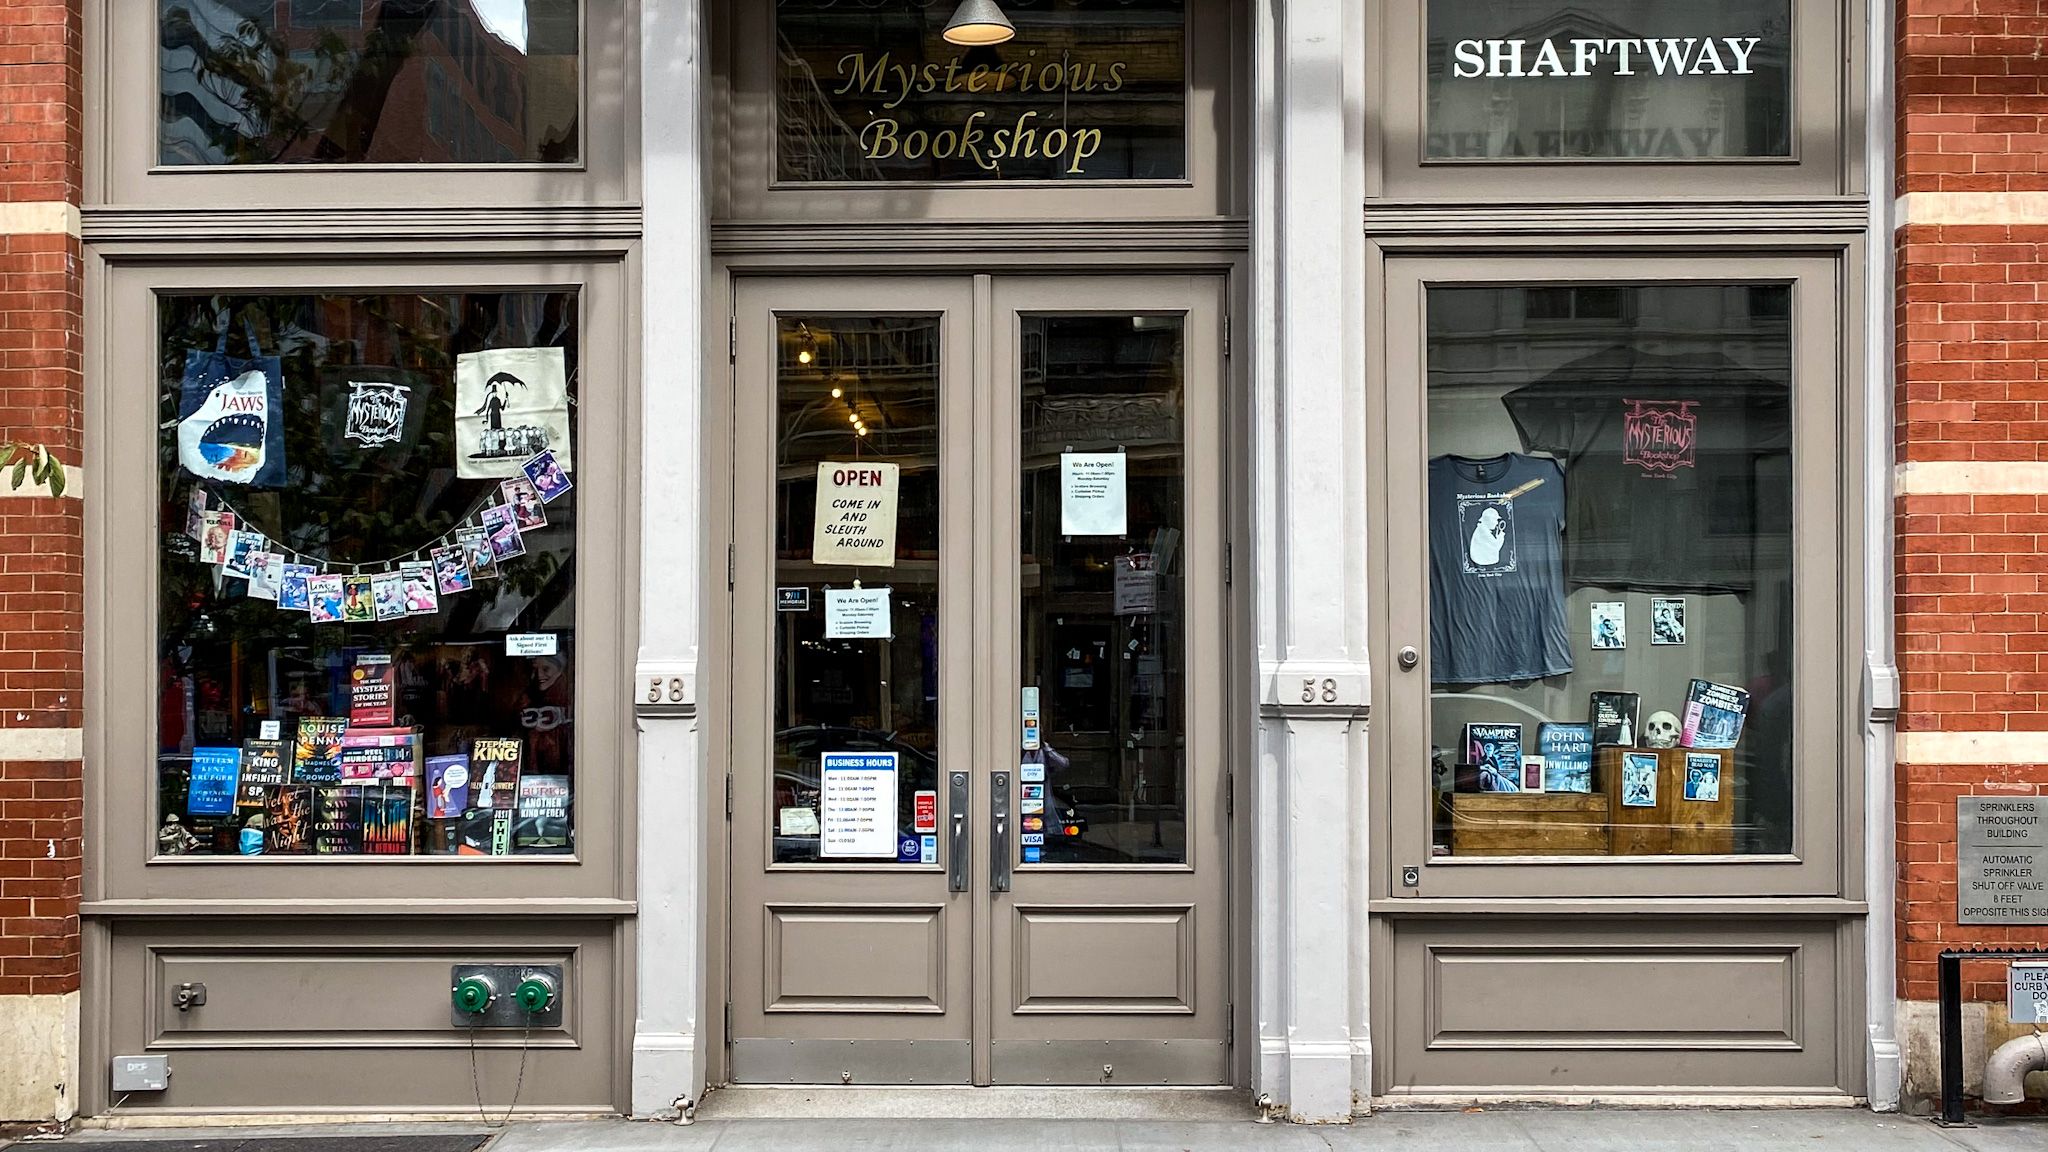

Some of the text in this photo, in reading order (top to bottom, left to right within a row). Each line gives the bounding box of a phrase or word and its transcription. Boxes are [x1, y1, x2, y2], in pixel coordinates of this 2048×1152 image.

[1453, 37, 1761, 78] SHAFTWAY
[834, 50, 1128, 109] Mysterious
[860, 111, 1102, 174] Bookshop
[221, 394, 264, 412] JAWS
[1628, 420, 1692, 454] MYSTERIOUS
[833, 470, 882, 487] OPEN
[832, 499, 881, 509] COME IN
[840, 513, 867, 522] AND
[825, 525, 867, 535] SLEUTH
[836, 538, 884, 548] AROUND
[785, 591, 800, 600] 9/11
[352, 685, 391, 693] MYSTERY
[648, 677, 684, 702] 58
[1302, 678, 1337, 703] 58
[1710, 684, 1738, 697] ZOMBIES!
[353, 693, 389, 701] STORIES
[1705, 688, 1740, 704] ZOMBIES!
[1699, 694, 1744, 713] ZOMBIES!
[301, 724, 345, 733] LOUISE
[1475, 727, 1517, 740] VAMPIRE
[301, 736, 343, 745] PENNY
[1545, 731, 1586, 742] JOHN
[474, 740, 520, 748] STEPHEN
[1550, 743, 1590, 752] HART
[343, 755, 384, 763] MURDERS
[473, 747, 518, 761] KING
[252, 756, 279, 768] KING
[827, 759, 893, 767] BUSINESS HOURS
[241, 773, 283, 783] INFINITE
[319, 787, 359, 797] NEVER
[523, 787, 567, 796] BURKE
[325, 799, 349, 809] SAW
[524, 798, 562, 807] ANOTHER
[1980, 803, 2035, 812] SPRINKLERS
[292, 799, 311, 818] the
[521, 808, 539, 818] KIND
[546, 808, 566, 818] EDEN
[494, 809, 509, 819] JUST
[1977, 816, 2039, 825] THROUGHOUT
[314, 822, 360, 831] COMING
[270, 819, 312, 850] Night
[1987, 829, 2028, 838] BUILDING
[1024, 835, 1043, 843] VISA
[319, 845, 354, 853] KURIAN
[1982, 855, 2033, 865] AUTOMATIC
[1983, 868, 2033, 877] SPRINKLER
[1972, 881, 2044, 890] SHUT OFF VALVE
[2000, 895, 2023, 903] FEET
[1963, 907, 2008, 917] OPPOSITE
[2009, 907, 2030, 917] THIS
[2014, 982, 2043, 991] CURB
[2032, 992, 2048, 1000] DO
